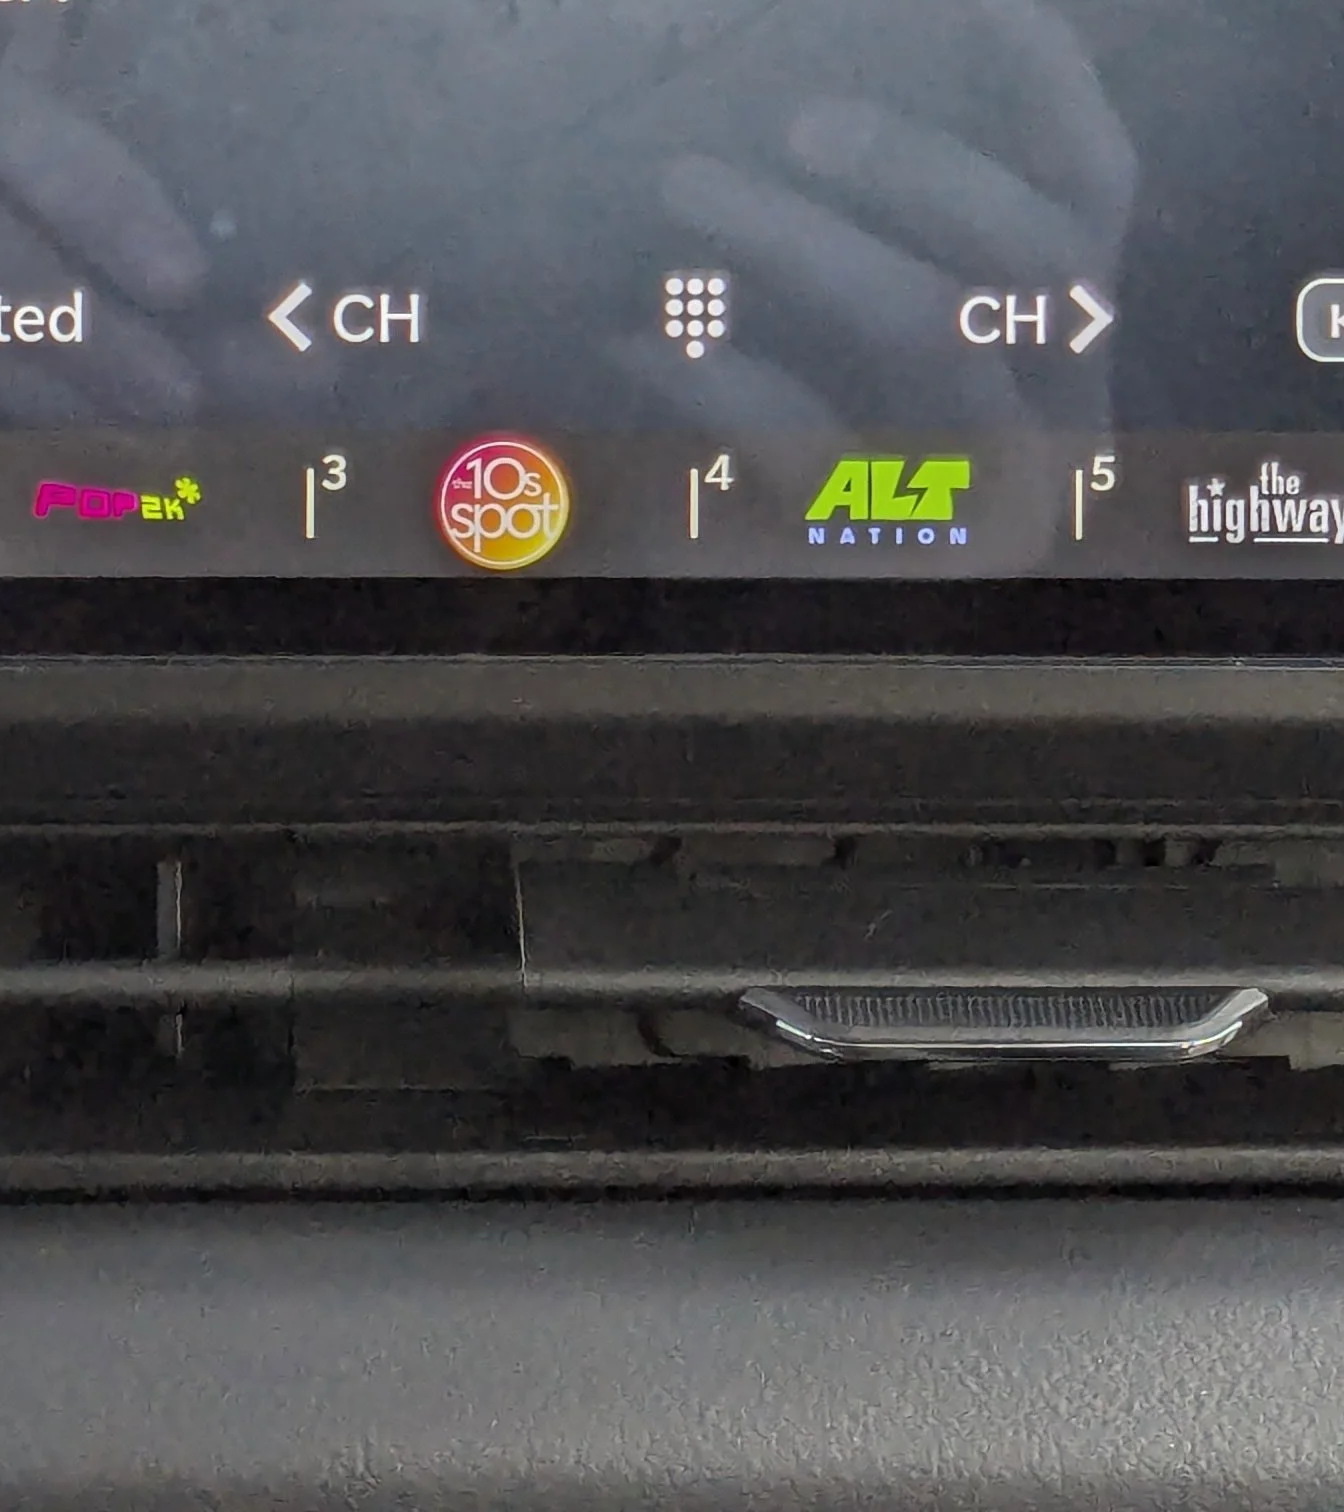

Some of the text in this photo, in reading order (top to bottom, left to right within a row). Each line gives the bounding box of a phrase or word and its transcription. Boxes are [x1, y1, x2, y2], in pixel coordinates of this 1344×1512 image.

[332, 293, 422, 344] CH
[959, 295, 1047, 346] CH
[322, 456, 348, 490] 3
[704, 456, 733, 491] 4
[804, 456, 971, 521] ALT
[1091, 456, 1116, 491] 5
[1259, 461, 1302, 496] the
[451, 492, 559, 554] spot
[807, 526, 967, 546] NATION
